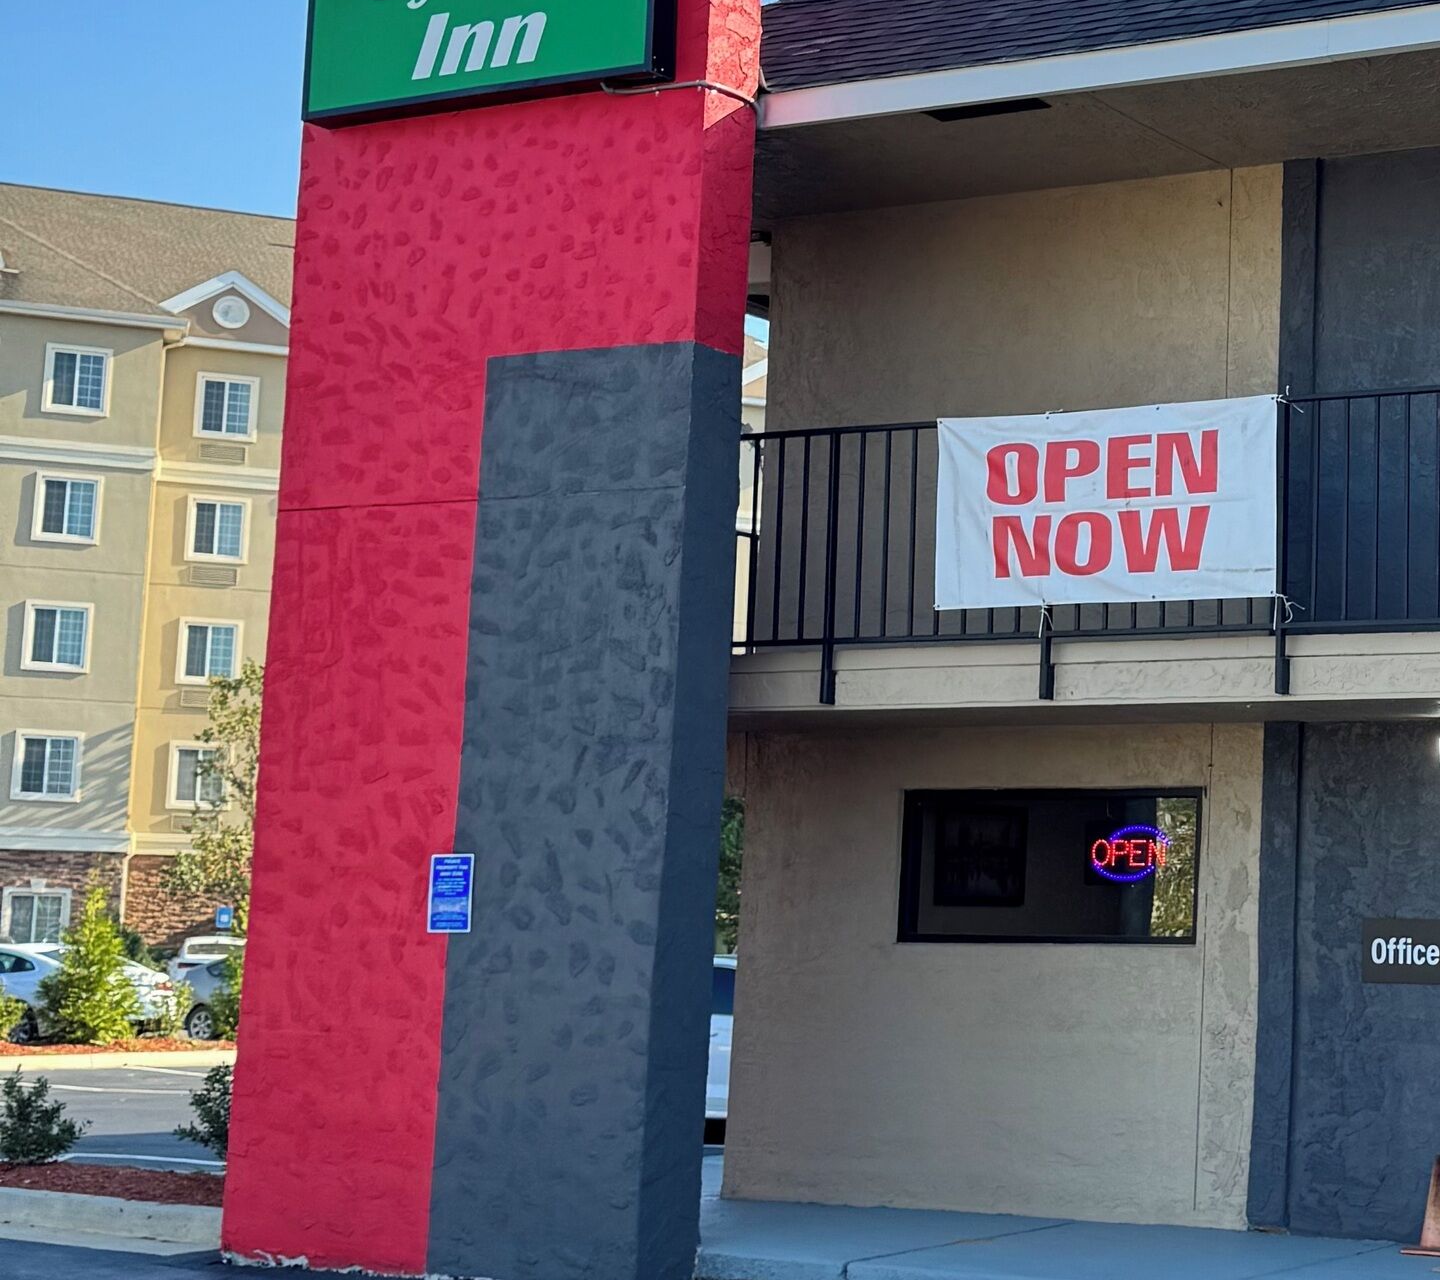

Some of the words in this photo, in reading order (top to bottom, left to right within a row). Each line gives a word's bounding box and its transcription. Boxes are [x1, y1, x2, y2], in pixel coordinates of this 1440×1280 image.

[411, 11, 548, 81] Inn
[986, 429, 1219, 506] OPEN
[992, 505, 1211, 579] NOW
[1091, 838, 1168, 867] OPEN
[1371, 937, 1440, 965] Office
